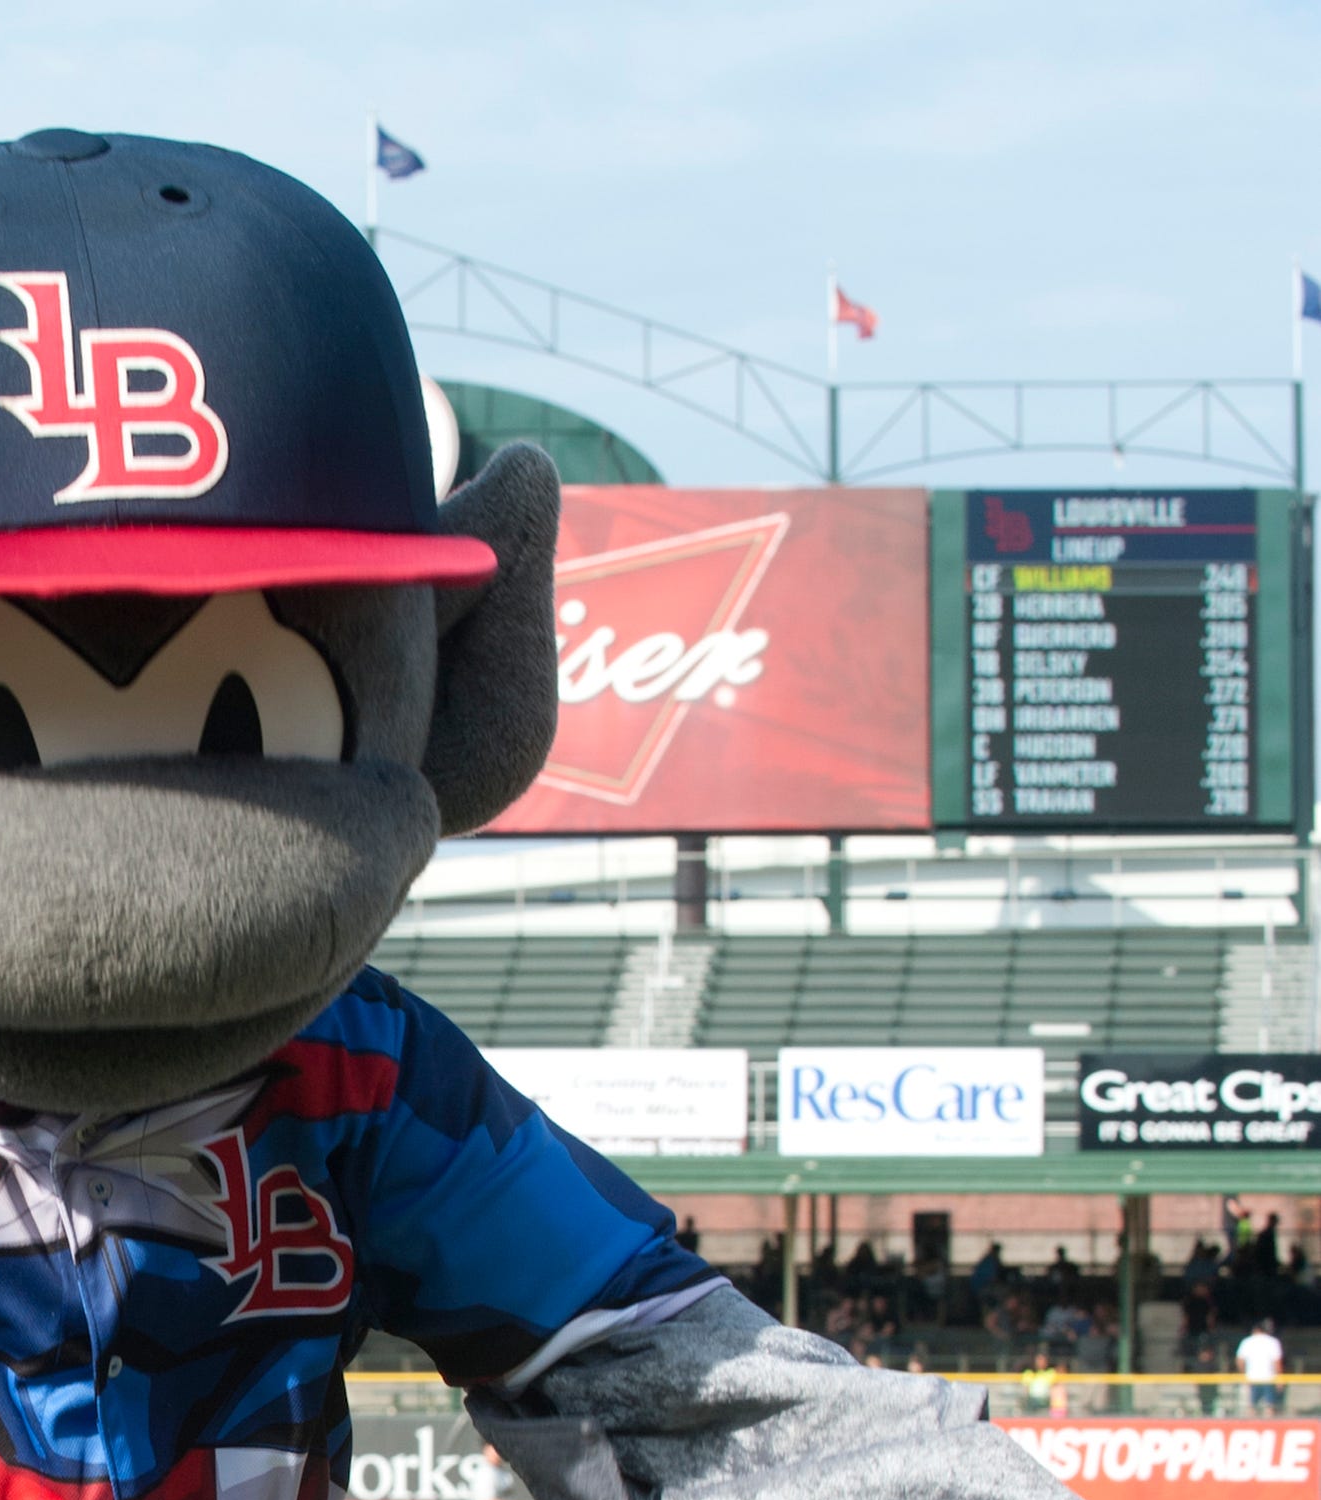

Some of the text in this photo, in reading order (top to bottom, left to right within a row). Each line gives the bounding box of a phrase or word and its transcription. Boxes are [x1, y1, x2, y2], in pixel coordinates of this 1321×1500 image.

[1053, 498, 1186, 527] LOUISVILLE
[1052, 536, 1125, 562] LINEUP
[792, 1063, 1025, 1123] ResCare
[1081, 1069, 1217, 1113] Great
[1140, 1121, 1212, 1142] GONNA
[1214, 1121, 1244, 1142] BE
[180, 1125, 354, 1326] LB
[349, 1425, 486, 1500] orks
[1008, 1427, 1314, 1482] NSTOPPABLE
